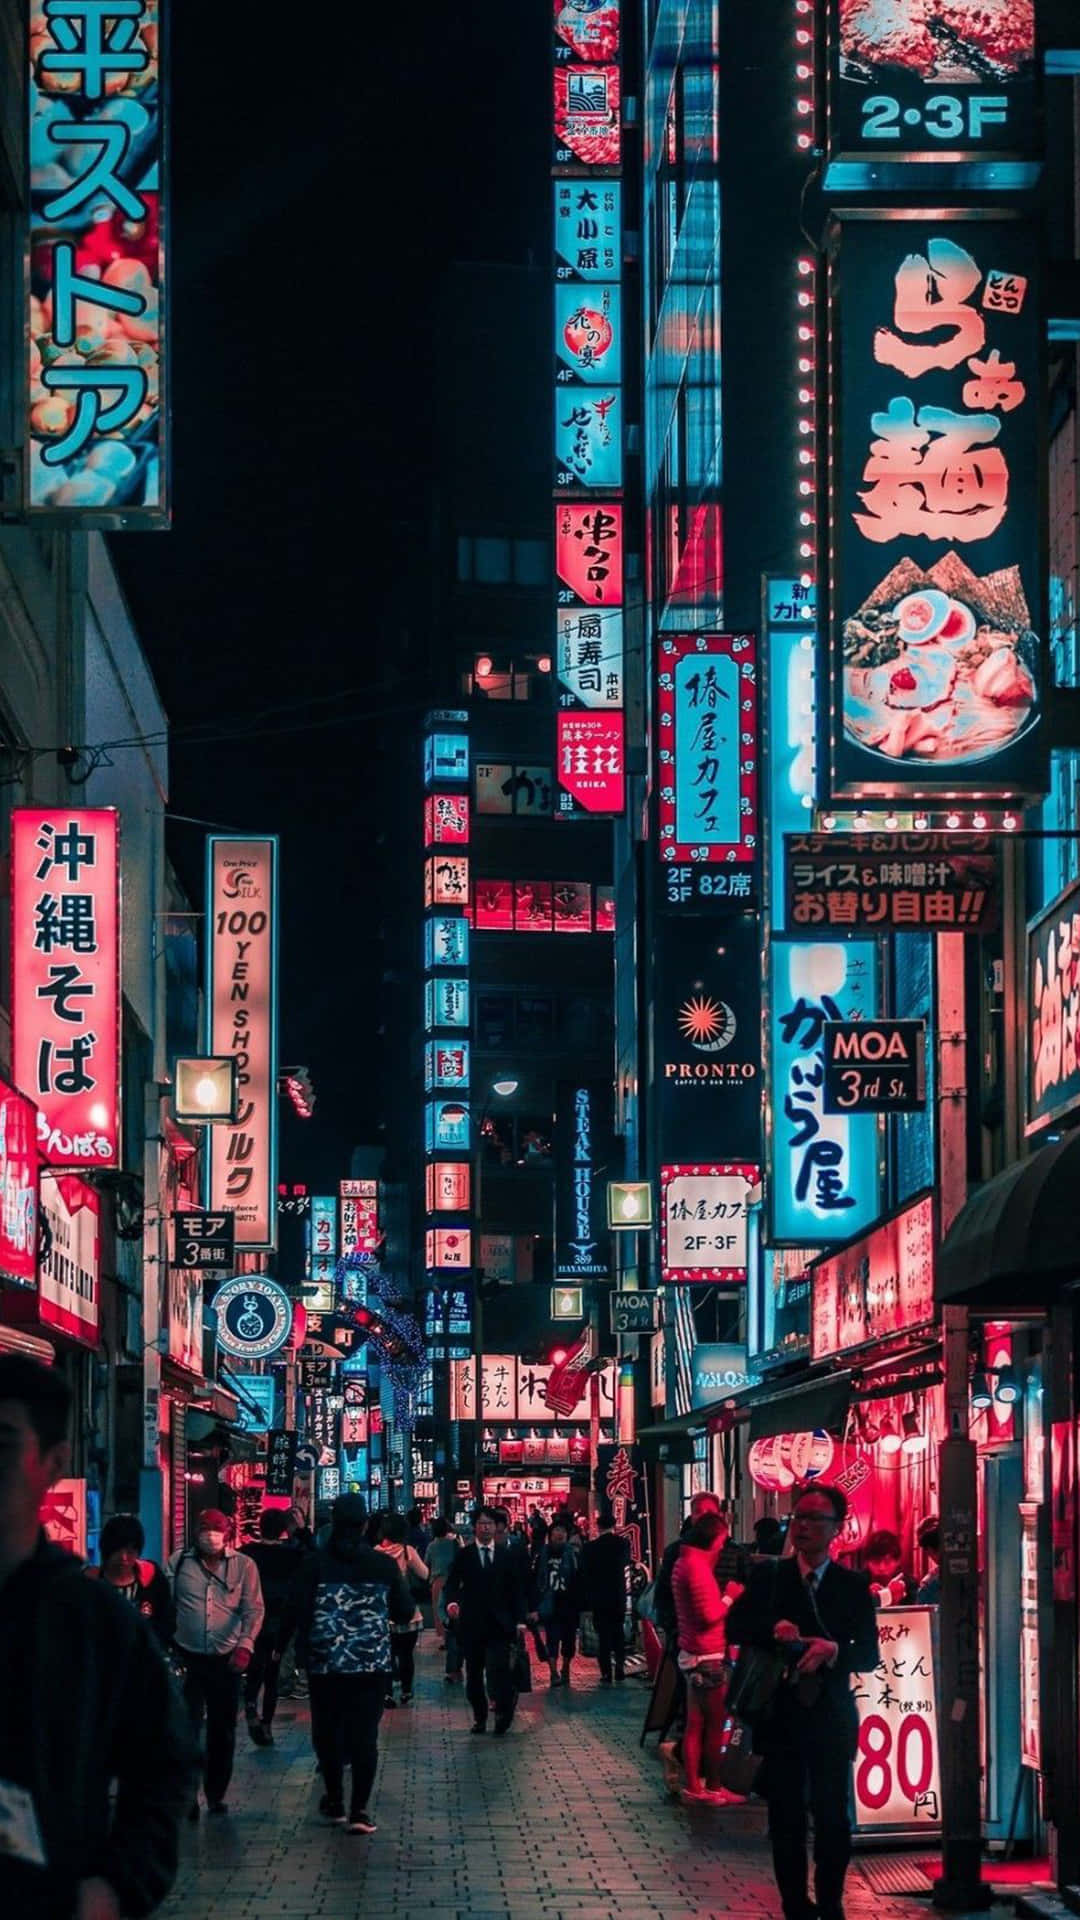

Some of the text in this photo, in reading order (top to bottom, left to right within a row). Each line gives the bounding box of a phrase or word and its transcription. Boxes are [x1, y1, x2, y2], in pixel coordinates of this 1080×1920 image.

[555, 47, 572, 60] 7F
[556, 150, 573, 161] 6F
[39, 0, 150, 468] 平ストア
[556, 267, 573, 279] 5F
[557, 370, 573, 382] 4F
[557, 472, 574, 485] 3F
[558, 591, 575, 603] 2F
[578, 613, 602, 692] 扇寿司
[606, 672, 619, 701] 本店
[560, 694, 576, 706] 1F
[684, 665, 731, 833] 椿屋カフェ
[576, 781, 607, 789] KEIKA
[667, 867, 692, 883] 2F
[699, 872, 752, 898] 82席
[793, 862, 950, 887] ライス&味噌汁
[667, 886, 692, 902] 3F
[216, 911, 268, 935] 100
[33, 820, 98, 1095] 沖縄そば
[230, 941, 252, 1001] YEN
[833, 1031, 909, 1060] MOA
[664, 1063, 756, 1078] PRONTO
[837, 1070, 881, 1107] 3rd
[574, 1088, 592, 1240] STEAK HOUSE
[183, 1217, 226, 1236] モア
[183, 1242, 226, 1265] 3番街
[316, 1220, 331, 1281] カラオ
[574, 1254, 592, 1265] 389
[558, 1264, 608, 1273] HAYASHIYA
[616, 1296, 650, 1309] MOA
[493, 1364, 510, 1408] 牛たん
[855, 1655, 931, 1682] きとん
